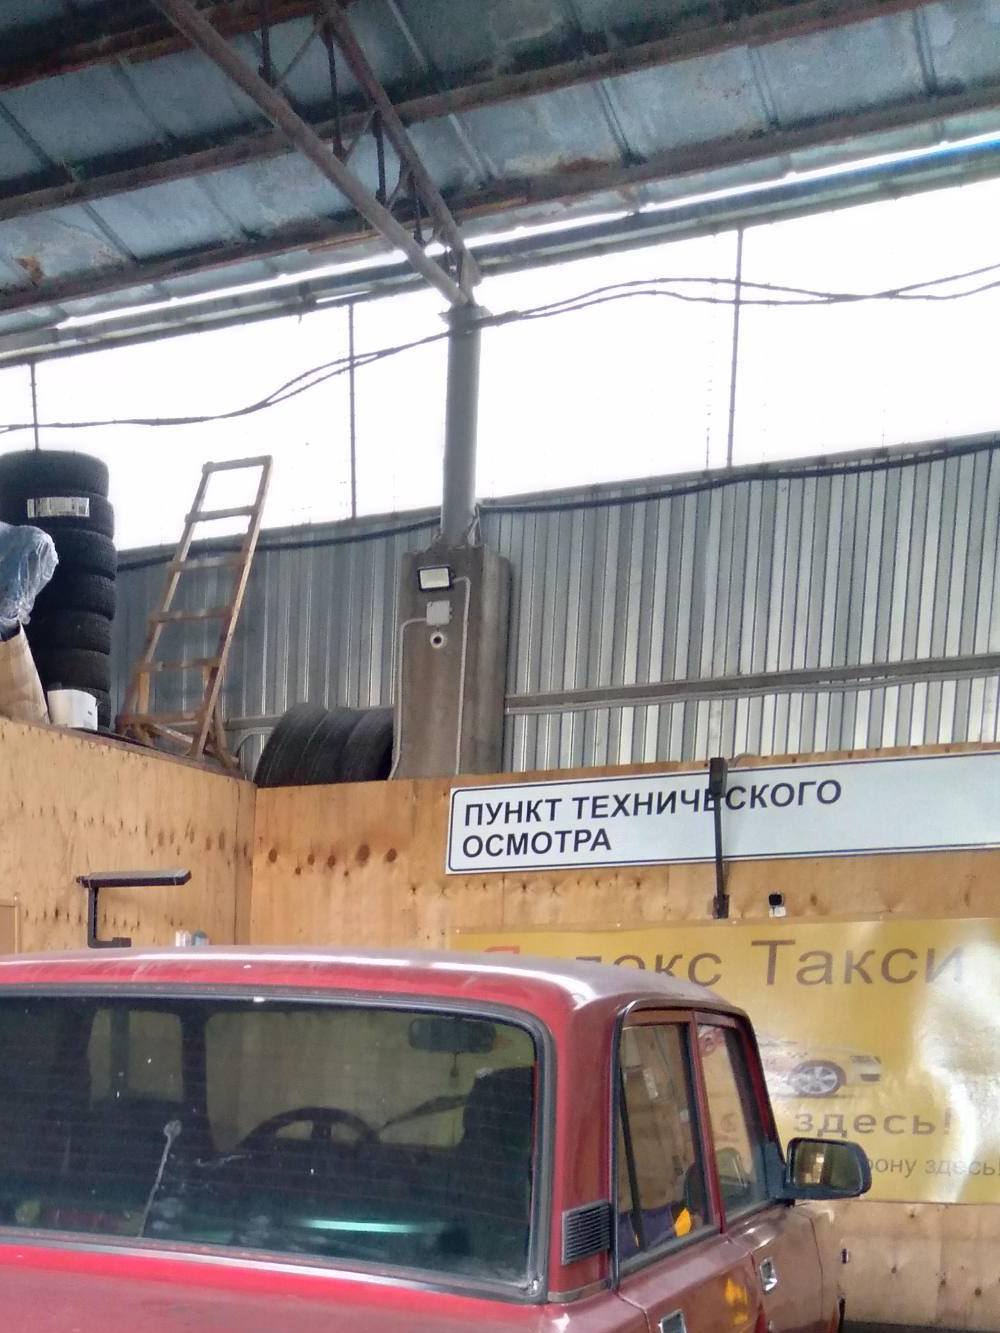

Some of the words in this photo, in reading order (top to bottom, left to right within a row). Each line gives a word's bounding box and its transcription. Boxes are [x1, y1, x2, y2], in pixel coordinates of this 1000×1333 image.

[464, 797, 562, 827] ПУНКТ
[573, 779, 841, 821] ТЕХНИЧЕСКОГО
[462, 827, 612, 859] ОСМОТРА
[751, 938, 965, 987] Такси
[793, 1107, 951, 1138] здесь!
